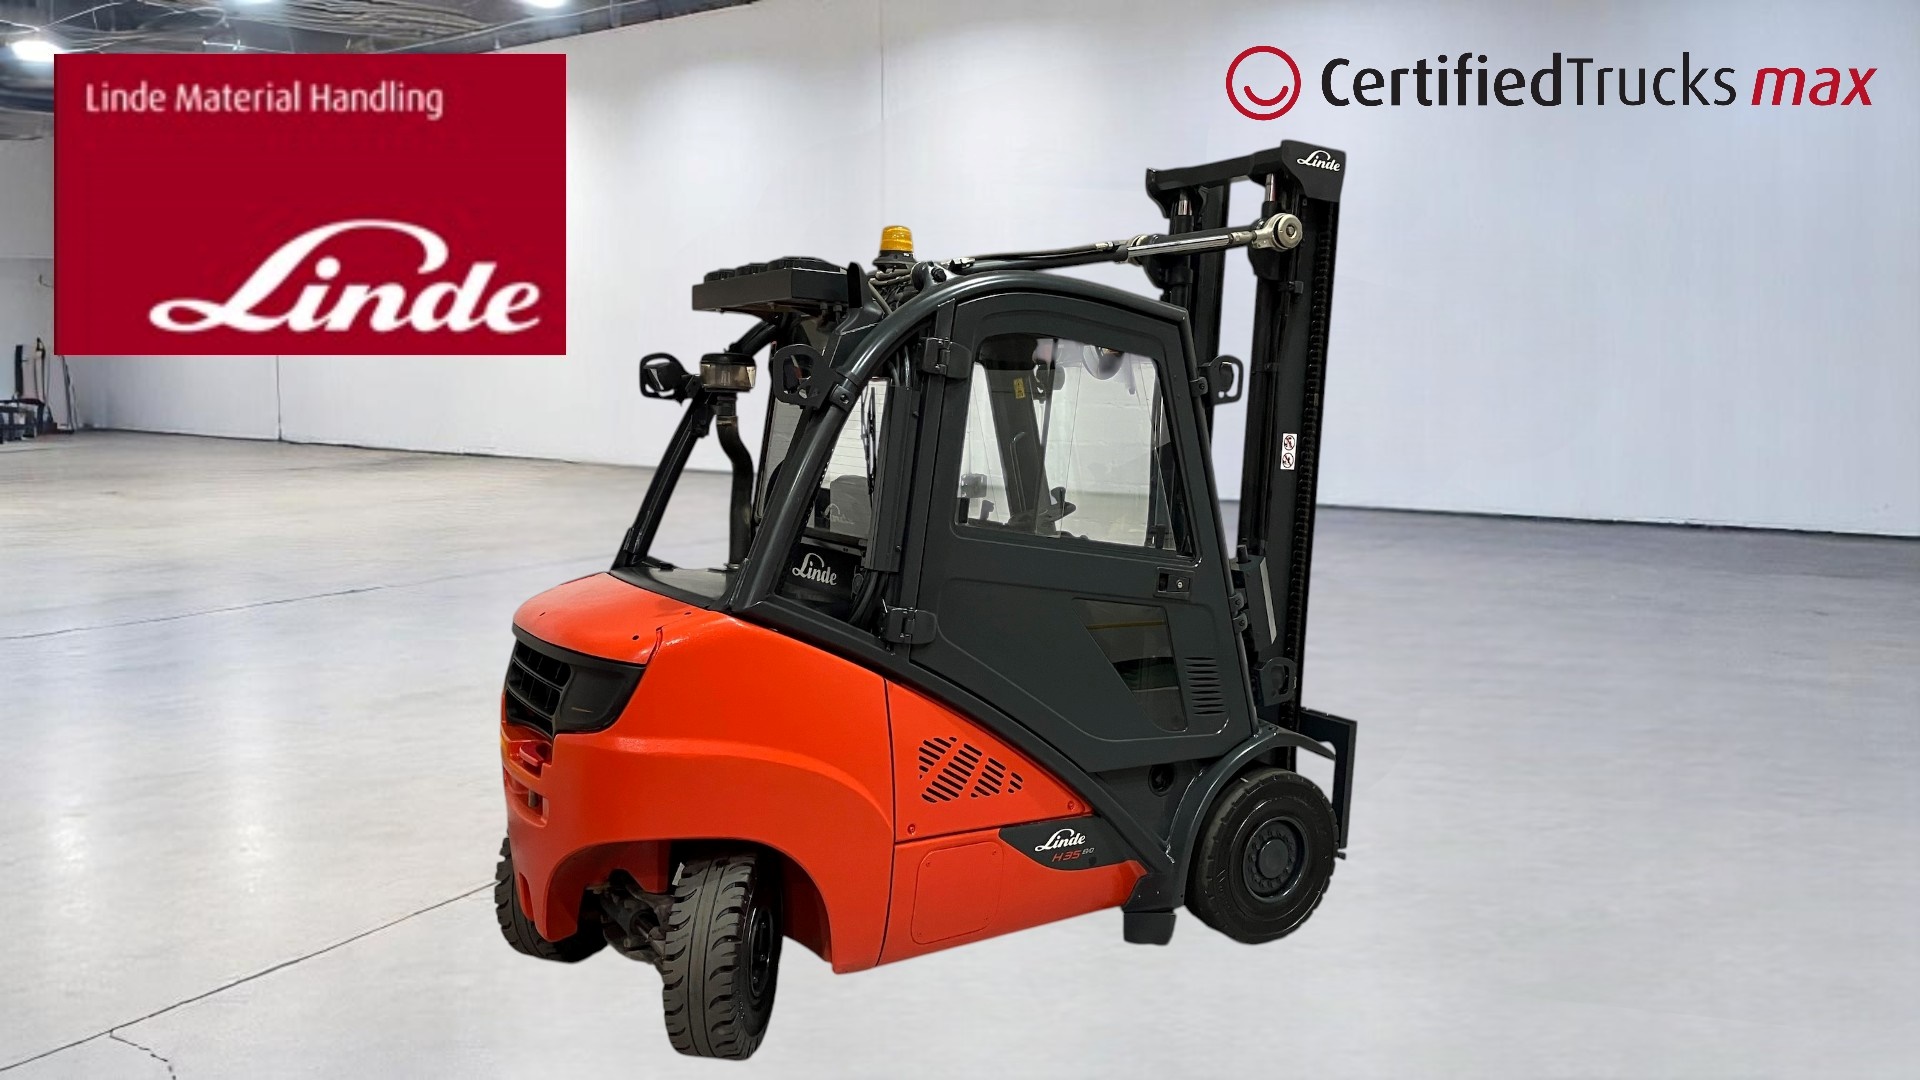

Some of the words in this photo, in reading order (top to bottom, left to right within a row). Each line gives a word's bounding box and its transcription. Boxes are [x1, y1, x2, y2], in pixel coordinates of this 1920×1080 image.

[1296, 149, 1341, 172] Linde
[791, 552, 837, 586] Linde
[1034, 828, 1086, 852] Linde
